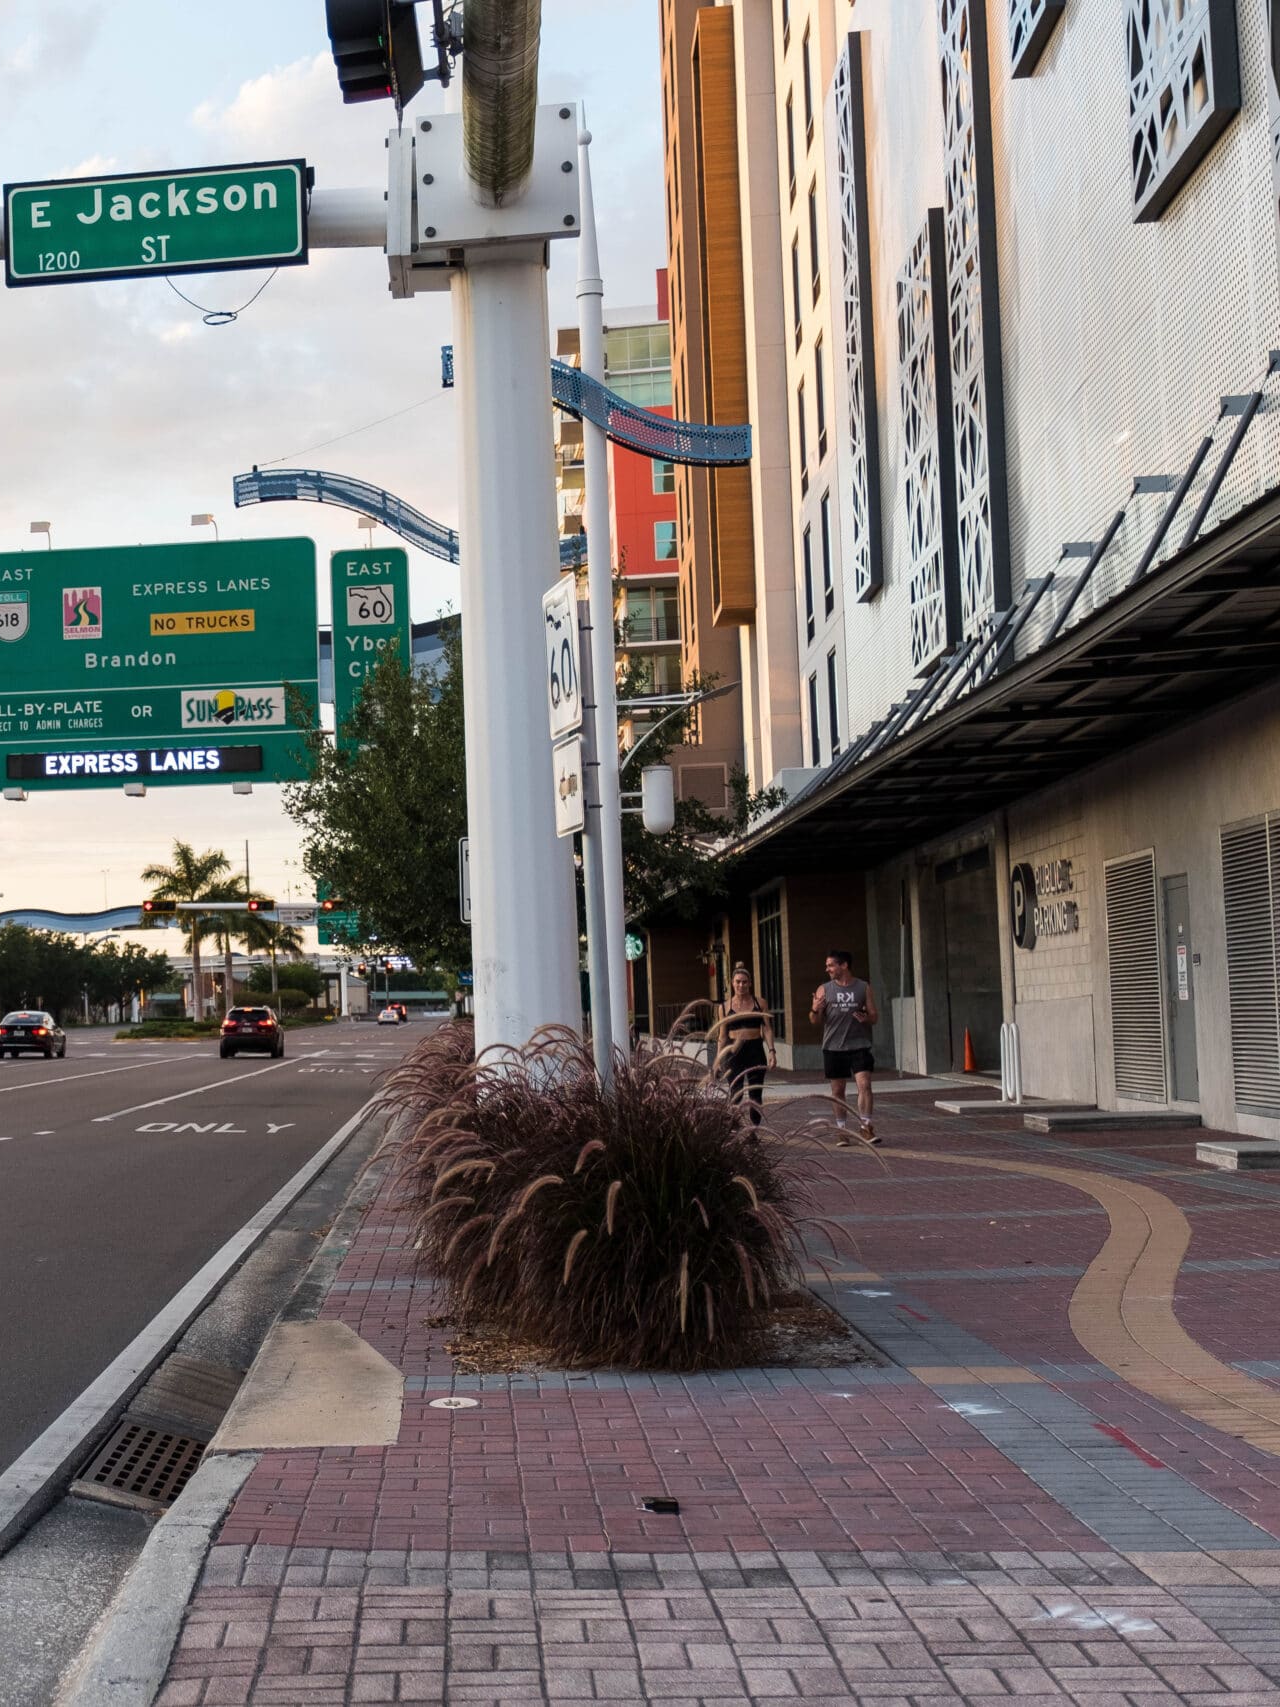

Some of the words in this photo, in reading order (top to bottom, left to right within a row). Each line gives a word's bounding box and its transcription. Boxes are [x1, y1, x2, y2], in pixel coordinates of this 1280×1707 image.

[31, 201, 52, 228] E
[76, 181, 278, 225] Jackson
[141, 235, 171, 263] ST
[38, 250, 81, 271] 1200
[346, 562, 392, 576] EAST
[132, 580, 208, 596] EXPRESS
[216, 577, 271, 592] LANES
[358, 600, 385, 619] 60
[154, 617, 176, 631] NO
[186, 614, 250, 629] TRUCKS
[85, 651, 177, 669] Brandon
[550, 637, 573, 710] 60
[131, 705, 153, 718] OR
[20, 720, 29, 731] TO
[36, 719, 61, 730] ADMIN
[68, 717, 103, 729] CHARGES
[45, 752, 139, 775] EXPRESS
[150, 750, 220, 771] LANES
[1035, 860, 1063, 896] PUBLIC
[1033, 900, 1068, 937] PARKING
[135, 1122, 297, 1134] ONLY
